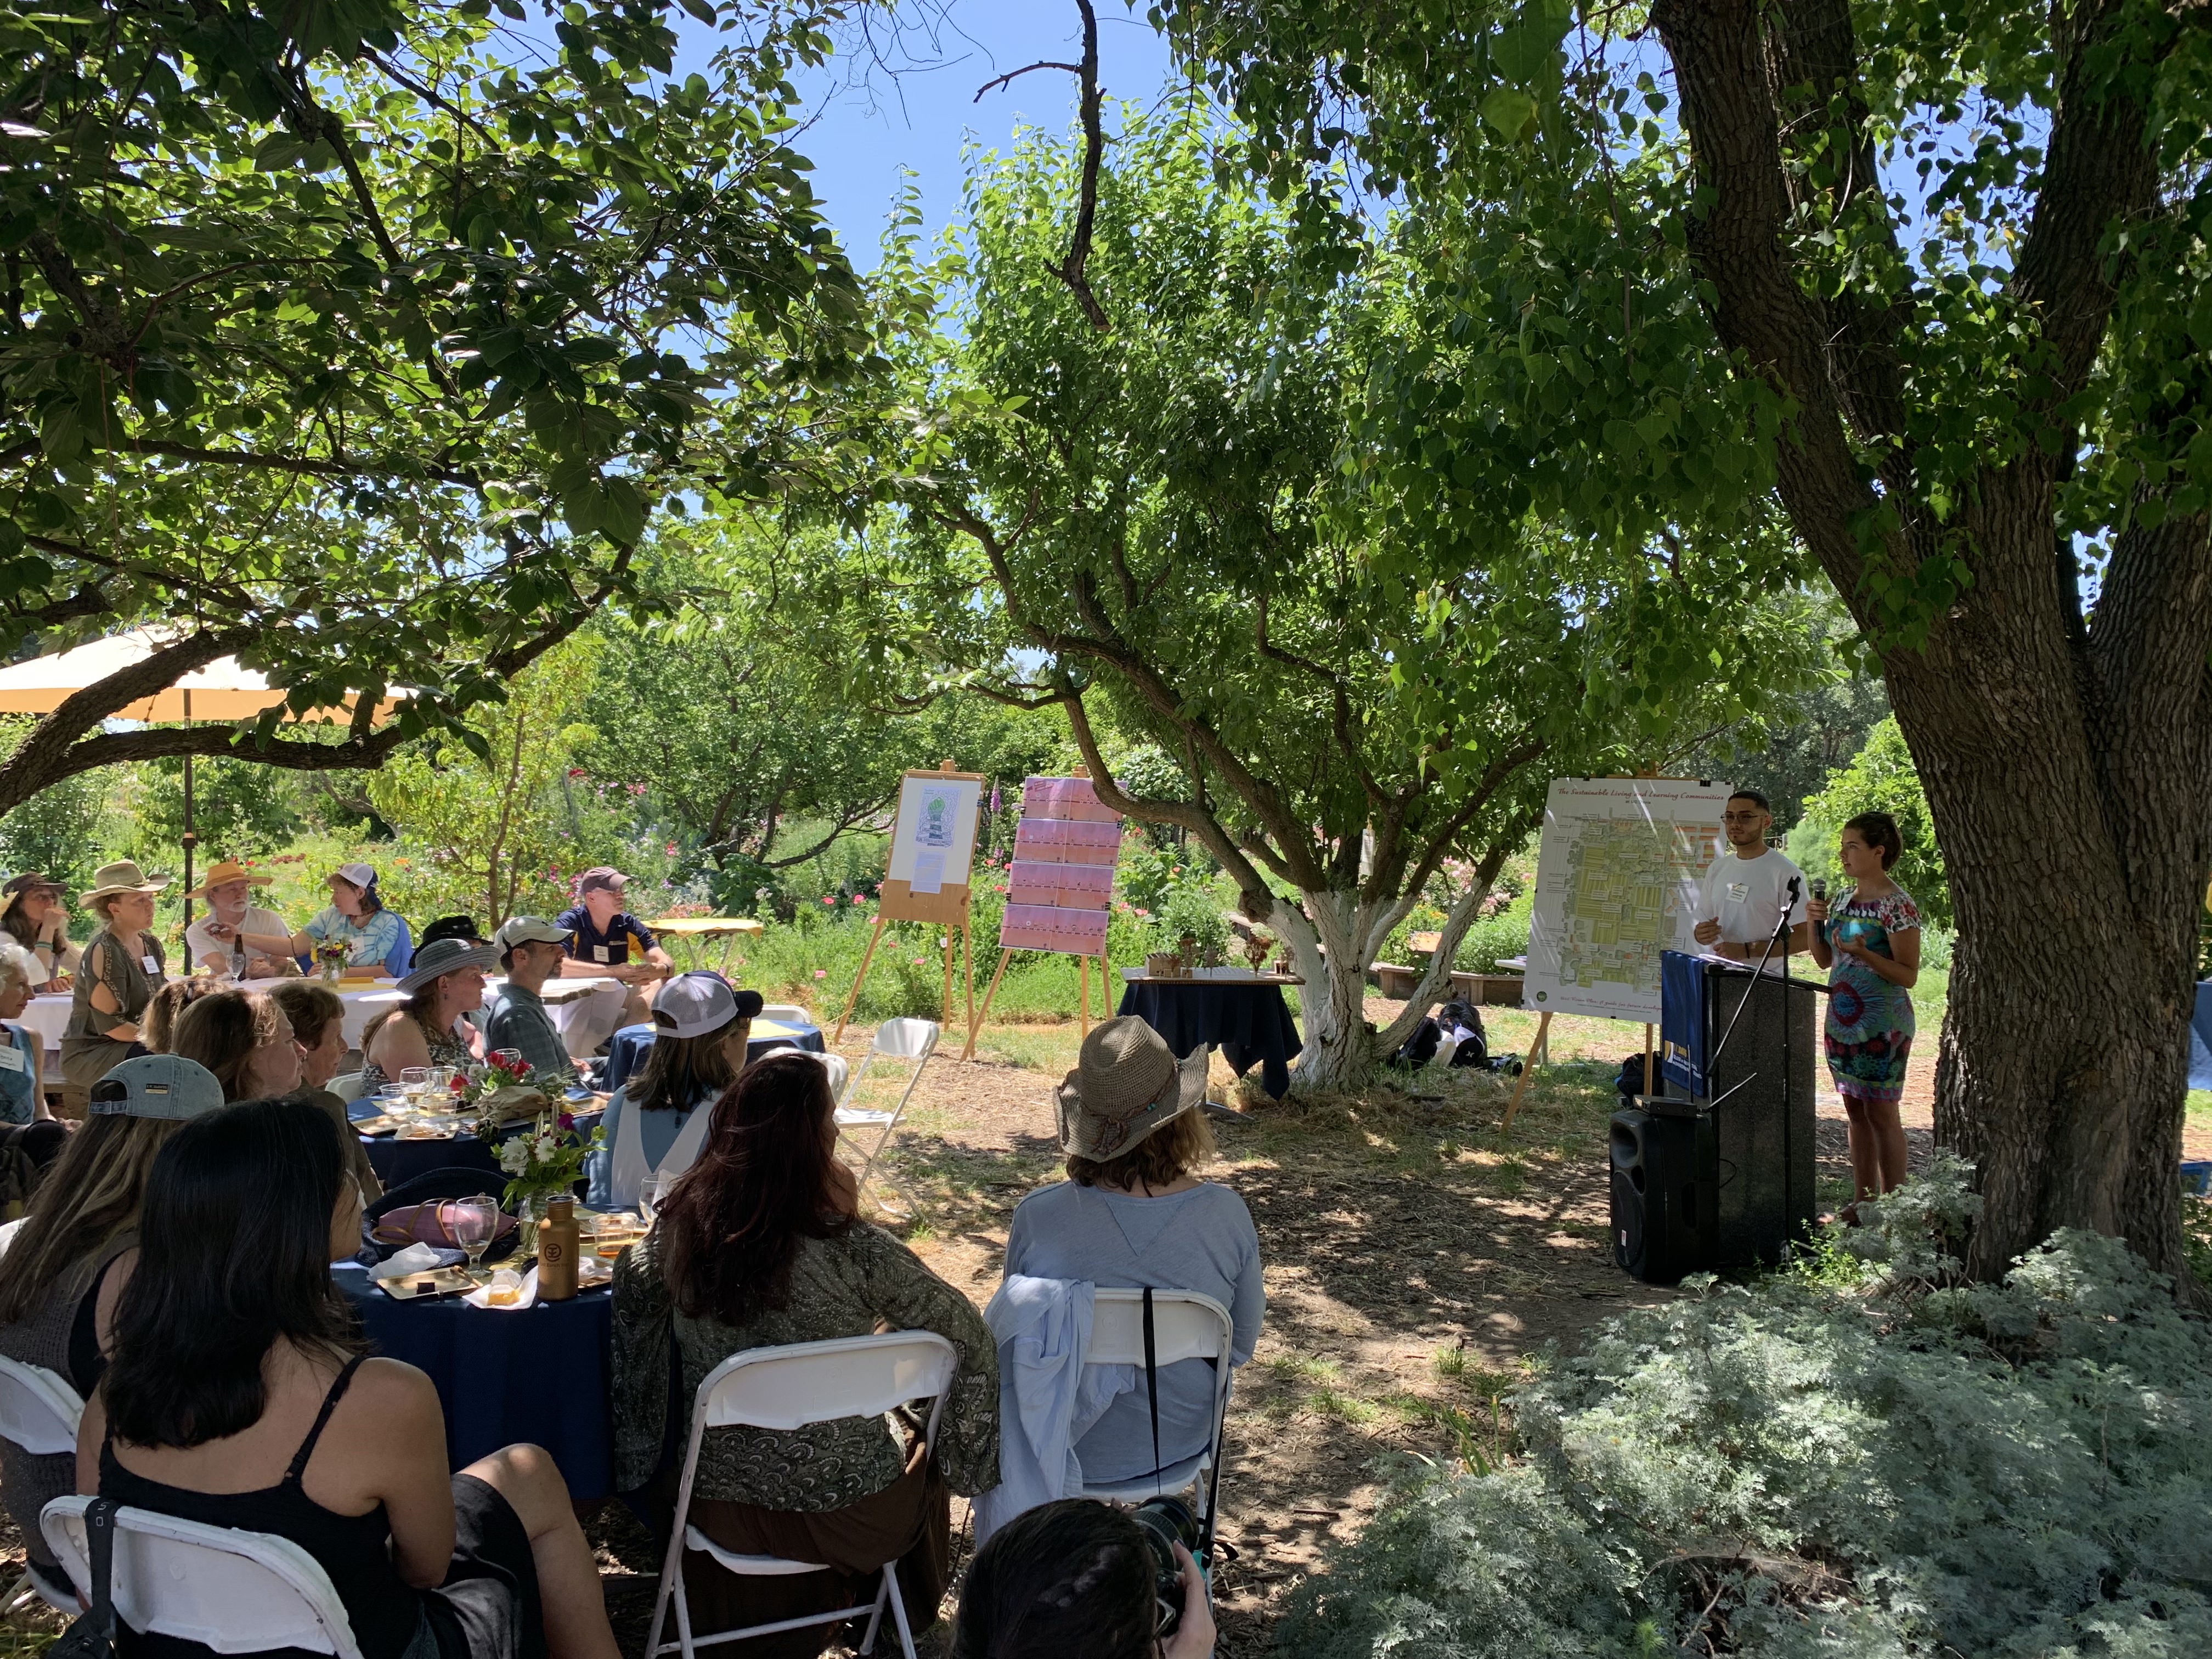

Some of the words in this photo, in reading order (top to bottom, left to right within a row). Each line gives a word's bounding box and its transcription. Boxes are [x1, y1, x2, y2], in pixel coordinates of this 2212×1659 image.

[1611, 789, 1632, 799] Living
[1649, 791, 1679, 801] Learning
[1680, 792, 1724, 800] Communities
